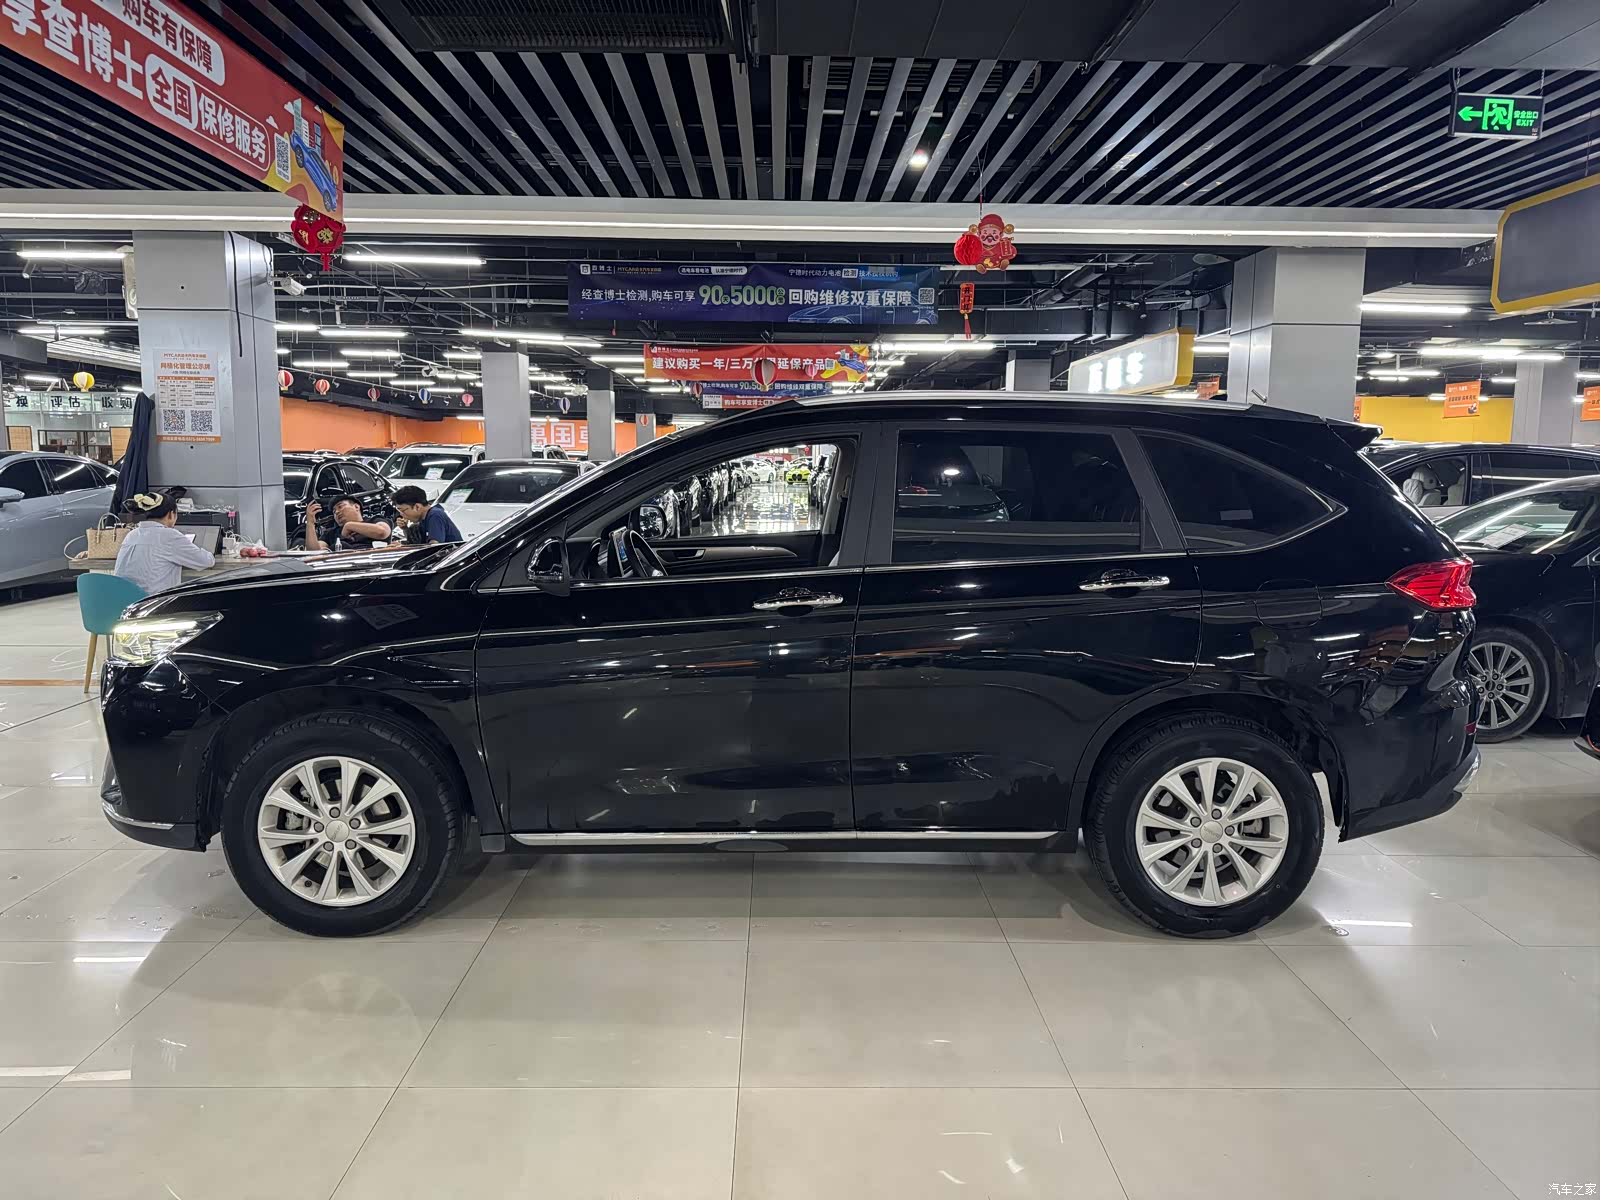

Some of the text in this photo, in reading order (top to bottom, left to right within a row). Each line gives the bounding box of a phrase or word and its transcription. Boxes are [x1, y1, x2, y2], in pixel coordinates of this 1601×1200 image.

[122, 0, 213, 73] 购车有保障
[1513, 110, 1539, 118] 安全出口
[199, 92, 266, 164] 保修服务
[788, 288, 912, 306] 回购维修双重保障
[50, 395, 81, 408] 评估
